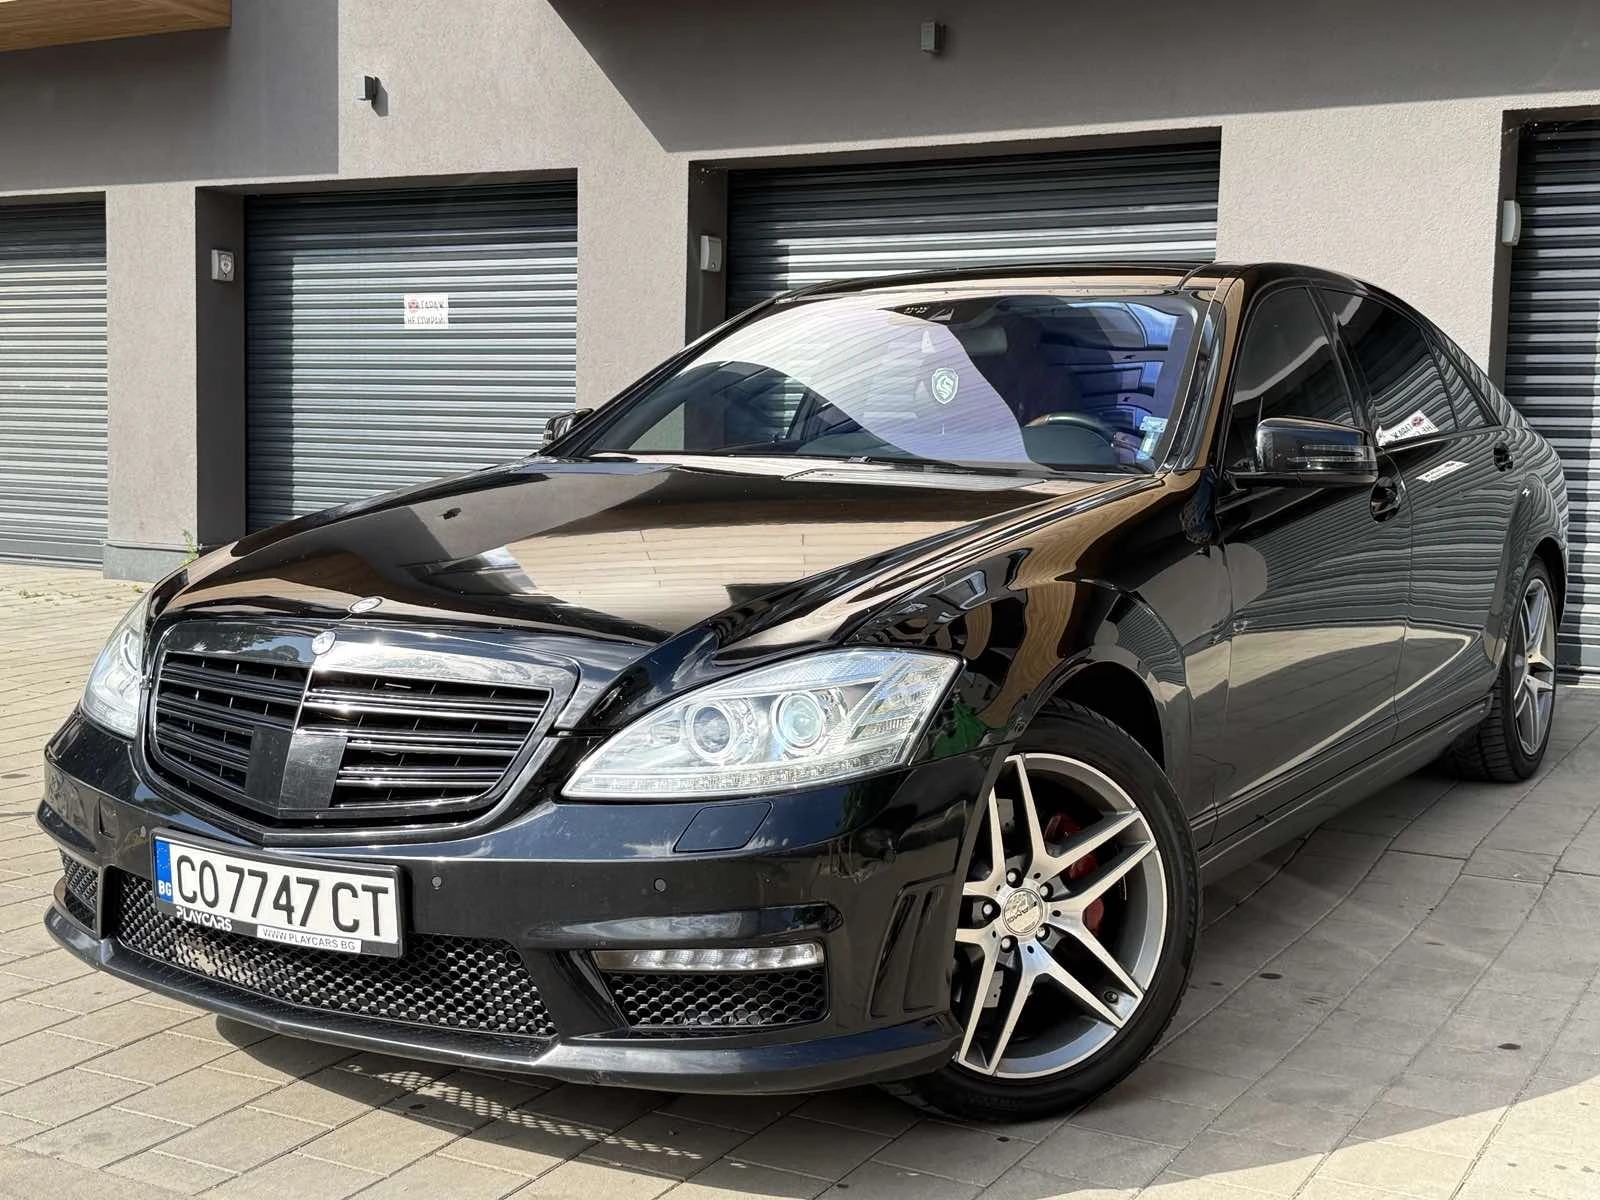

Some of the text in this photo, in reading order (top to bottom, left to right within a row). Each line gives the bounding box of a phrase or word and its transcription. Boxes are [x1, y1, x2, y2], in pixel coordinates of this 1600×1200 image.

[158, 880, 172, 897] BG
[176, 854, 389, 937] CO 7747 CT
[175, 905, 233, 932] PLAYCARS
